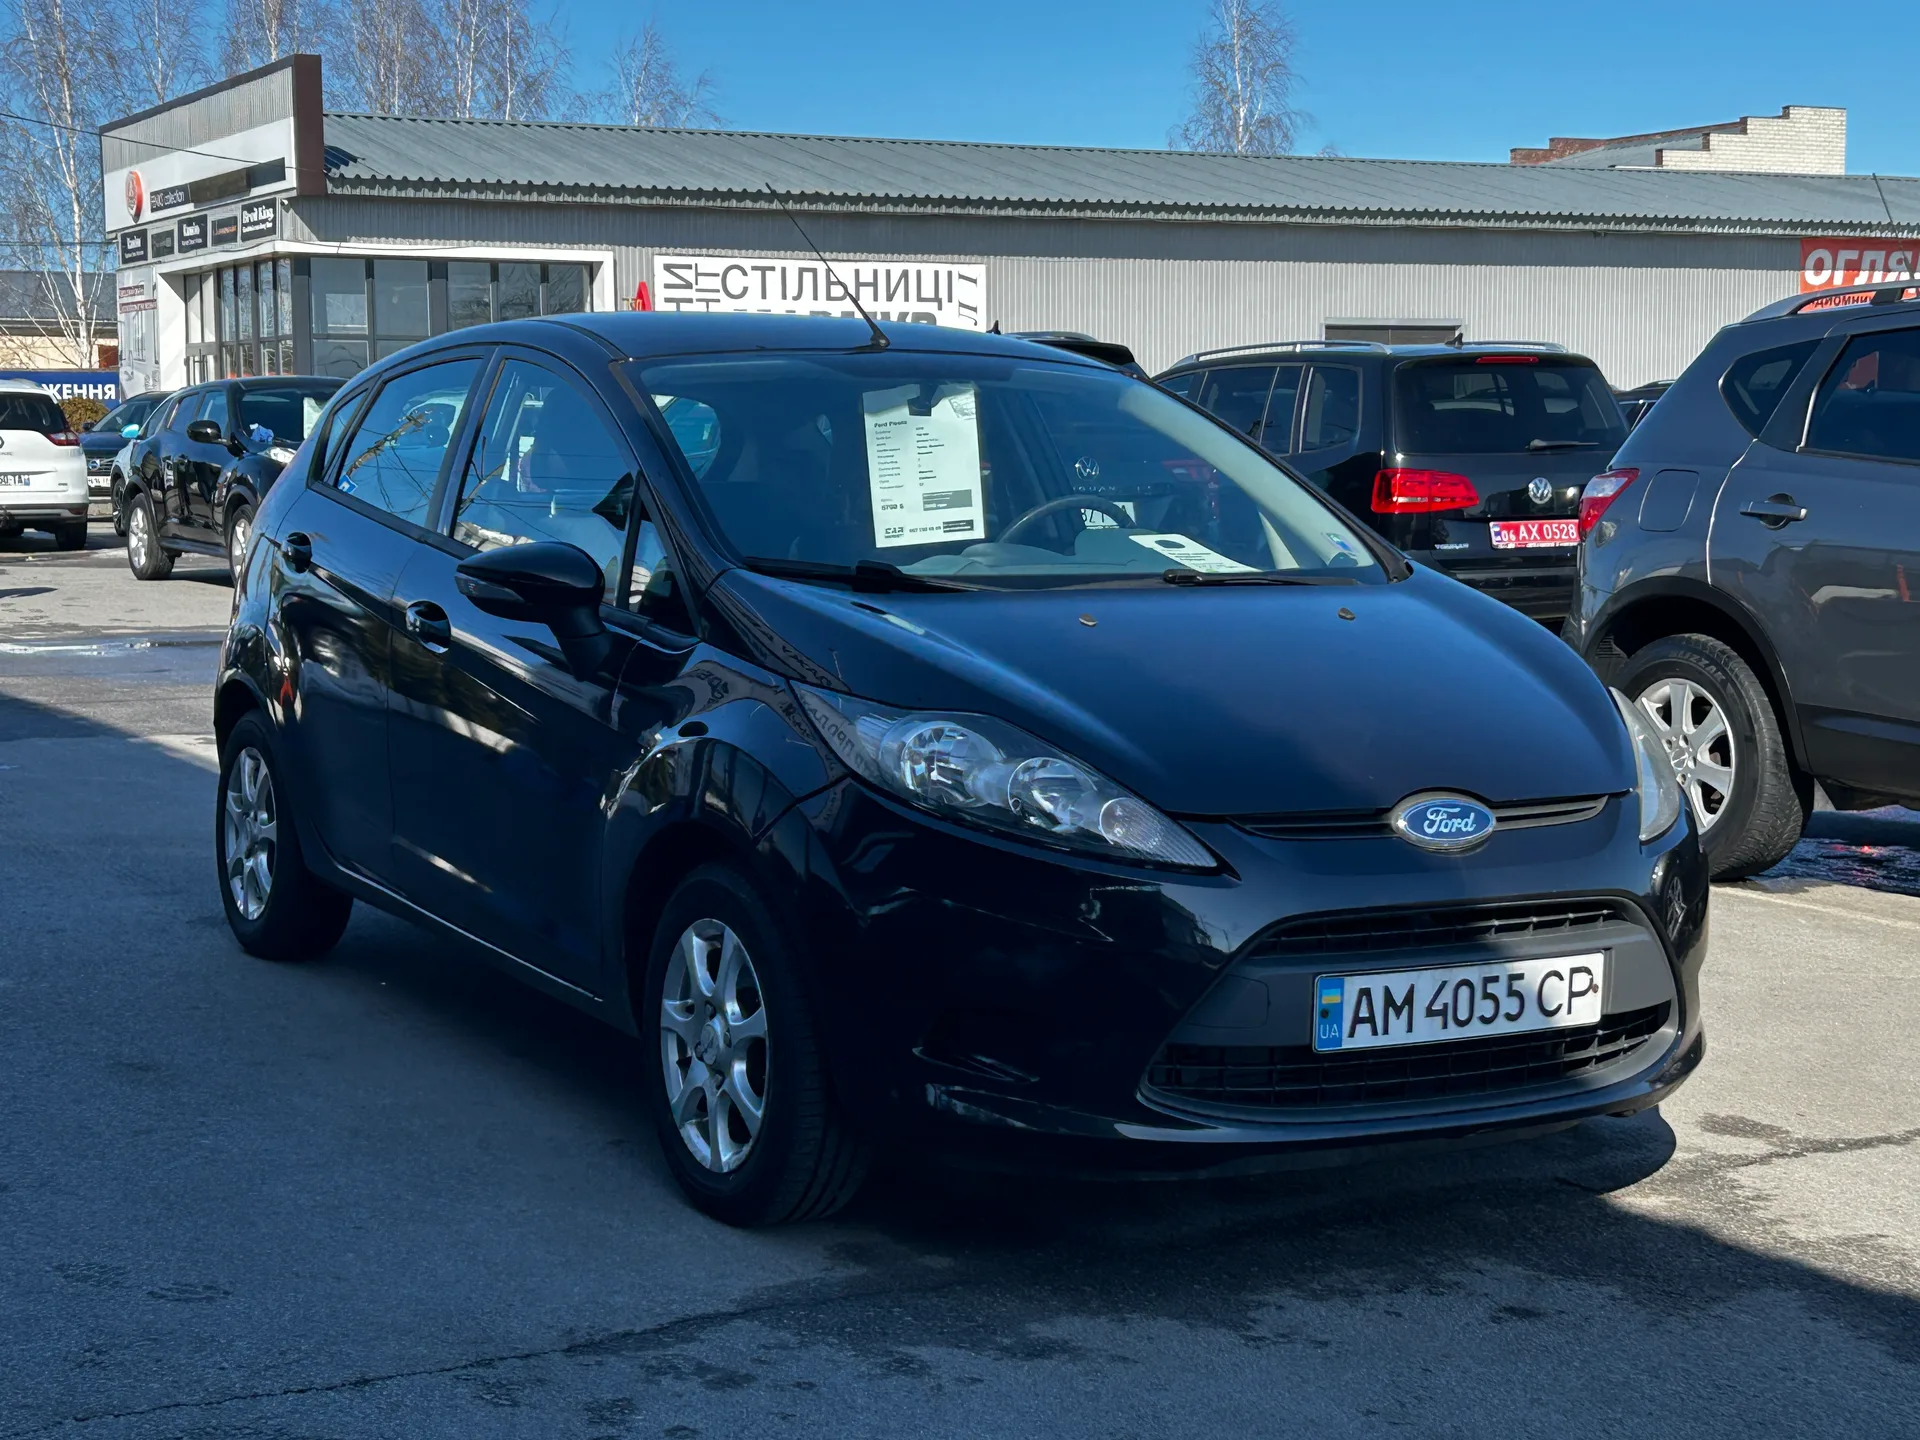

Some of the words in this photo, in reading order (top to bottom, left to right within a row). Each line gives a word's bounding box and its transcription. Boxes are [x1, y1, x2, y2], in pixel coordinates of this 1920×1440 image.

[1804, 248, 1920, 285] ОГЛЯ
[721, 264, 953, 311] СТІЛЬНИЦІ
[1518, 524, 1541, 541] AX
[1543, 523, 1577, 540] 0528
[1423, 806, 1477, 835] Ford
[1348, 983, 1415, 1038] AM
[1424, 972, 1525, 1030] 4055
[1537, 965, 1594, 1018] CP
[1320, 1024, 1339, 1039] UA
